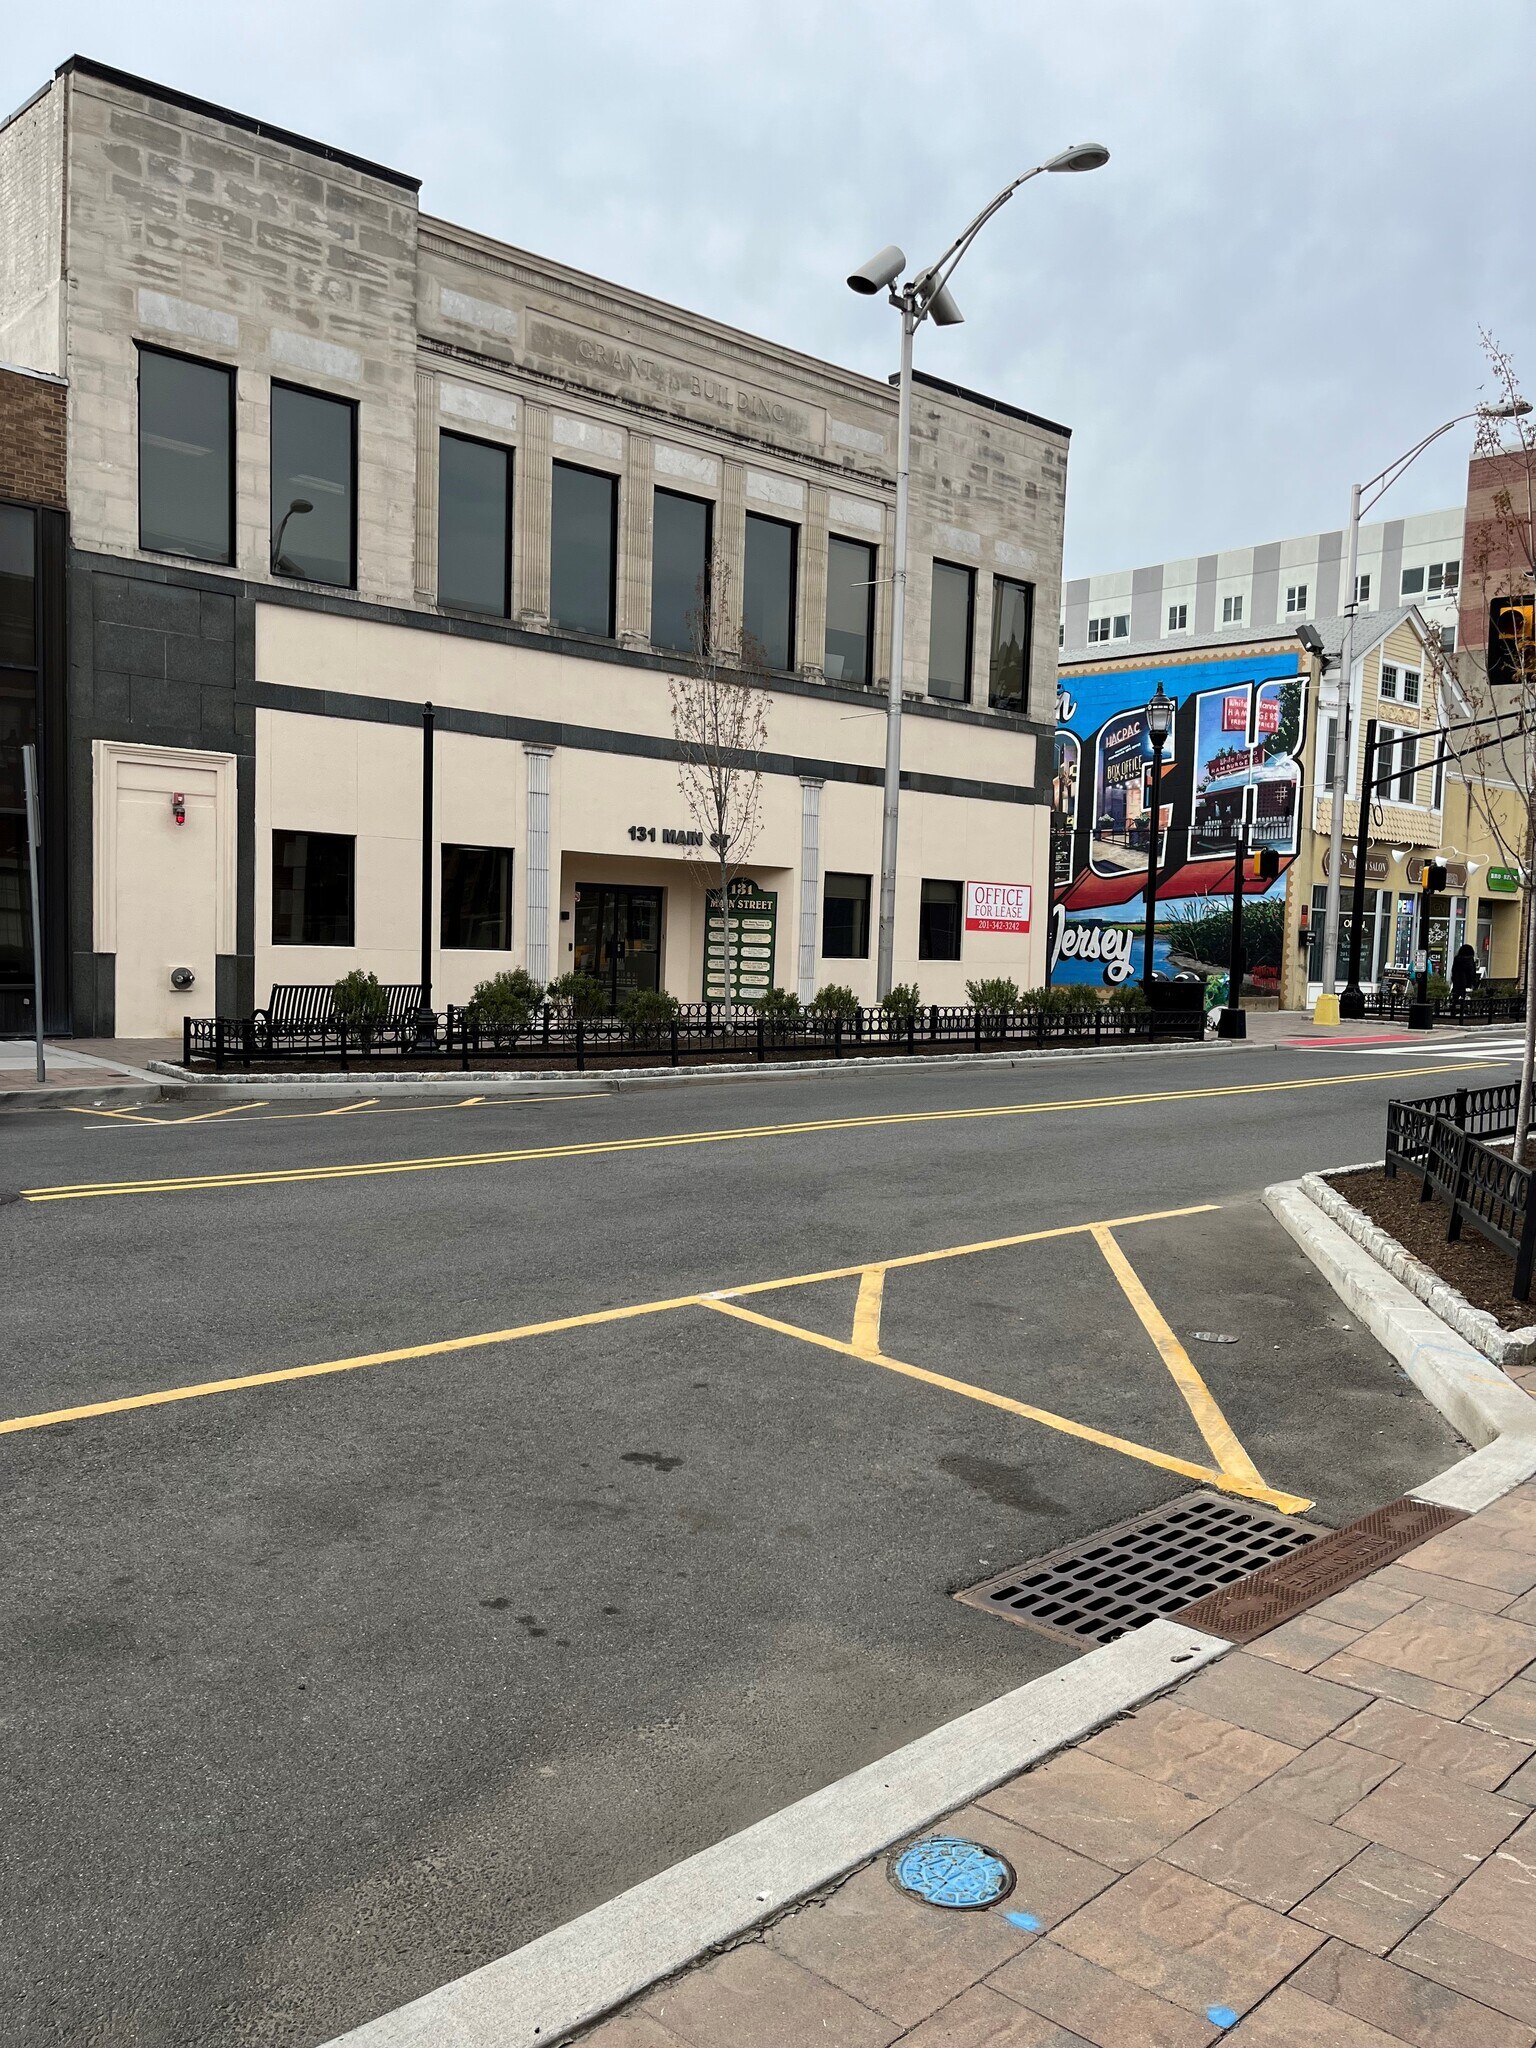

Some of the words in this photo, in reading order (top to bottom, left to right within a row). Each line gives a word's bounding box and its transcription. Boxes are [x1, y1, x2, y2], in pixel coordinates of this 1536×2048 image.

[578, 339, 655, 384] GRANT
[690, 375, 785, 422] BUILDING
[1105, 721, 1141, 748] HACPAC
[1107, 763, 1121, 780] BOX
[1121, 754, 1142, 776] OFFICE
[1211, 756, 1260, 774] HAMBURGES
[627, 825, 656, 842] 131
[662, 828, 703, 847] MAIN
[709, 832, 731, 849] ST
[1368, 861, 1386, 872] SALON
[731, 883, 753, 895] 131
[974, 886, 1024, 907] OFFICE
[710, 899, 735, 909] MAN
[737, 899, 773, 910] STREET
[974, 904, 993, 917] FOR
[994, 905, 1023, 919] LEASE
[978, 920, 1020, 931] 201-342-3242
[1051, 903, 1135, 982] Jersey
[1353, 1537, 1387, 1556] DUMP
[1332, 1550, 1357, 1566] NO
[1288, 1562, 1340, 1589] WASTE
